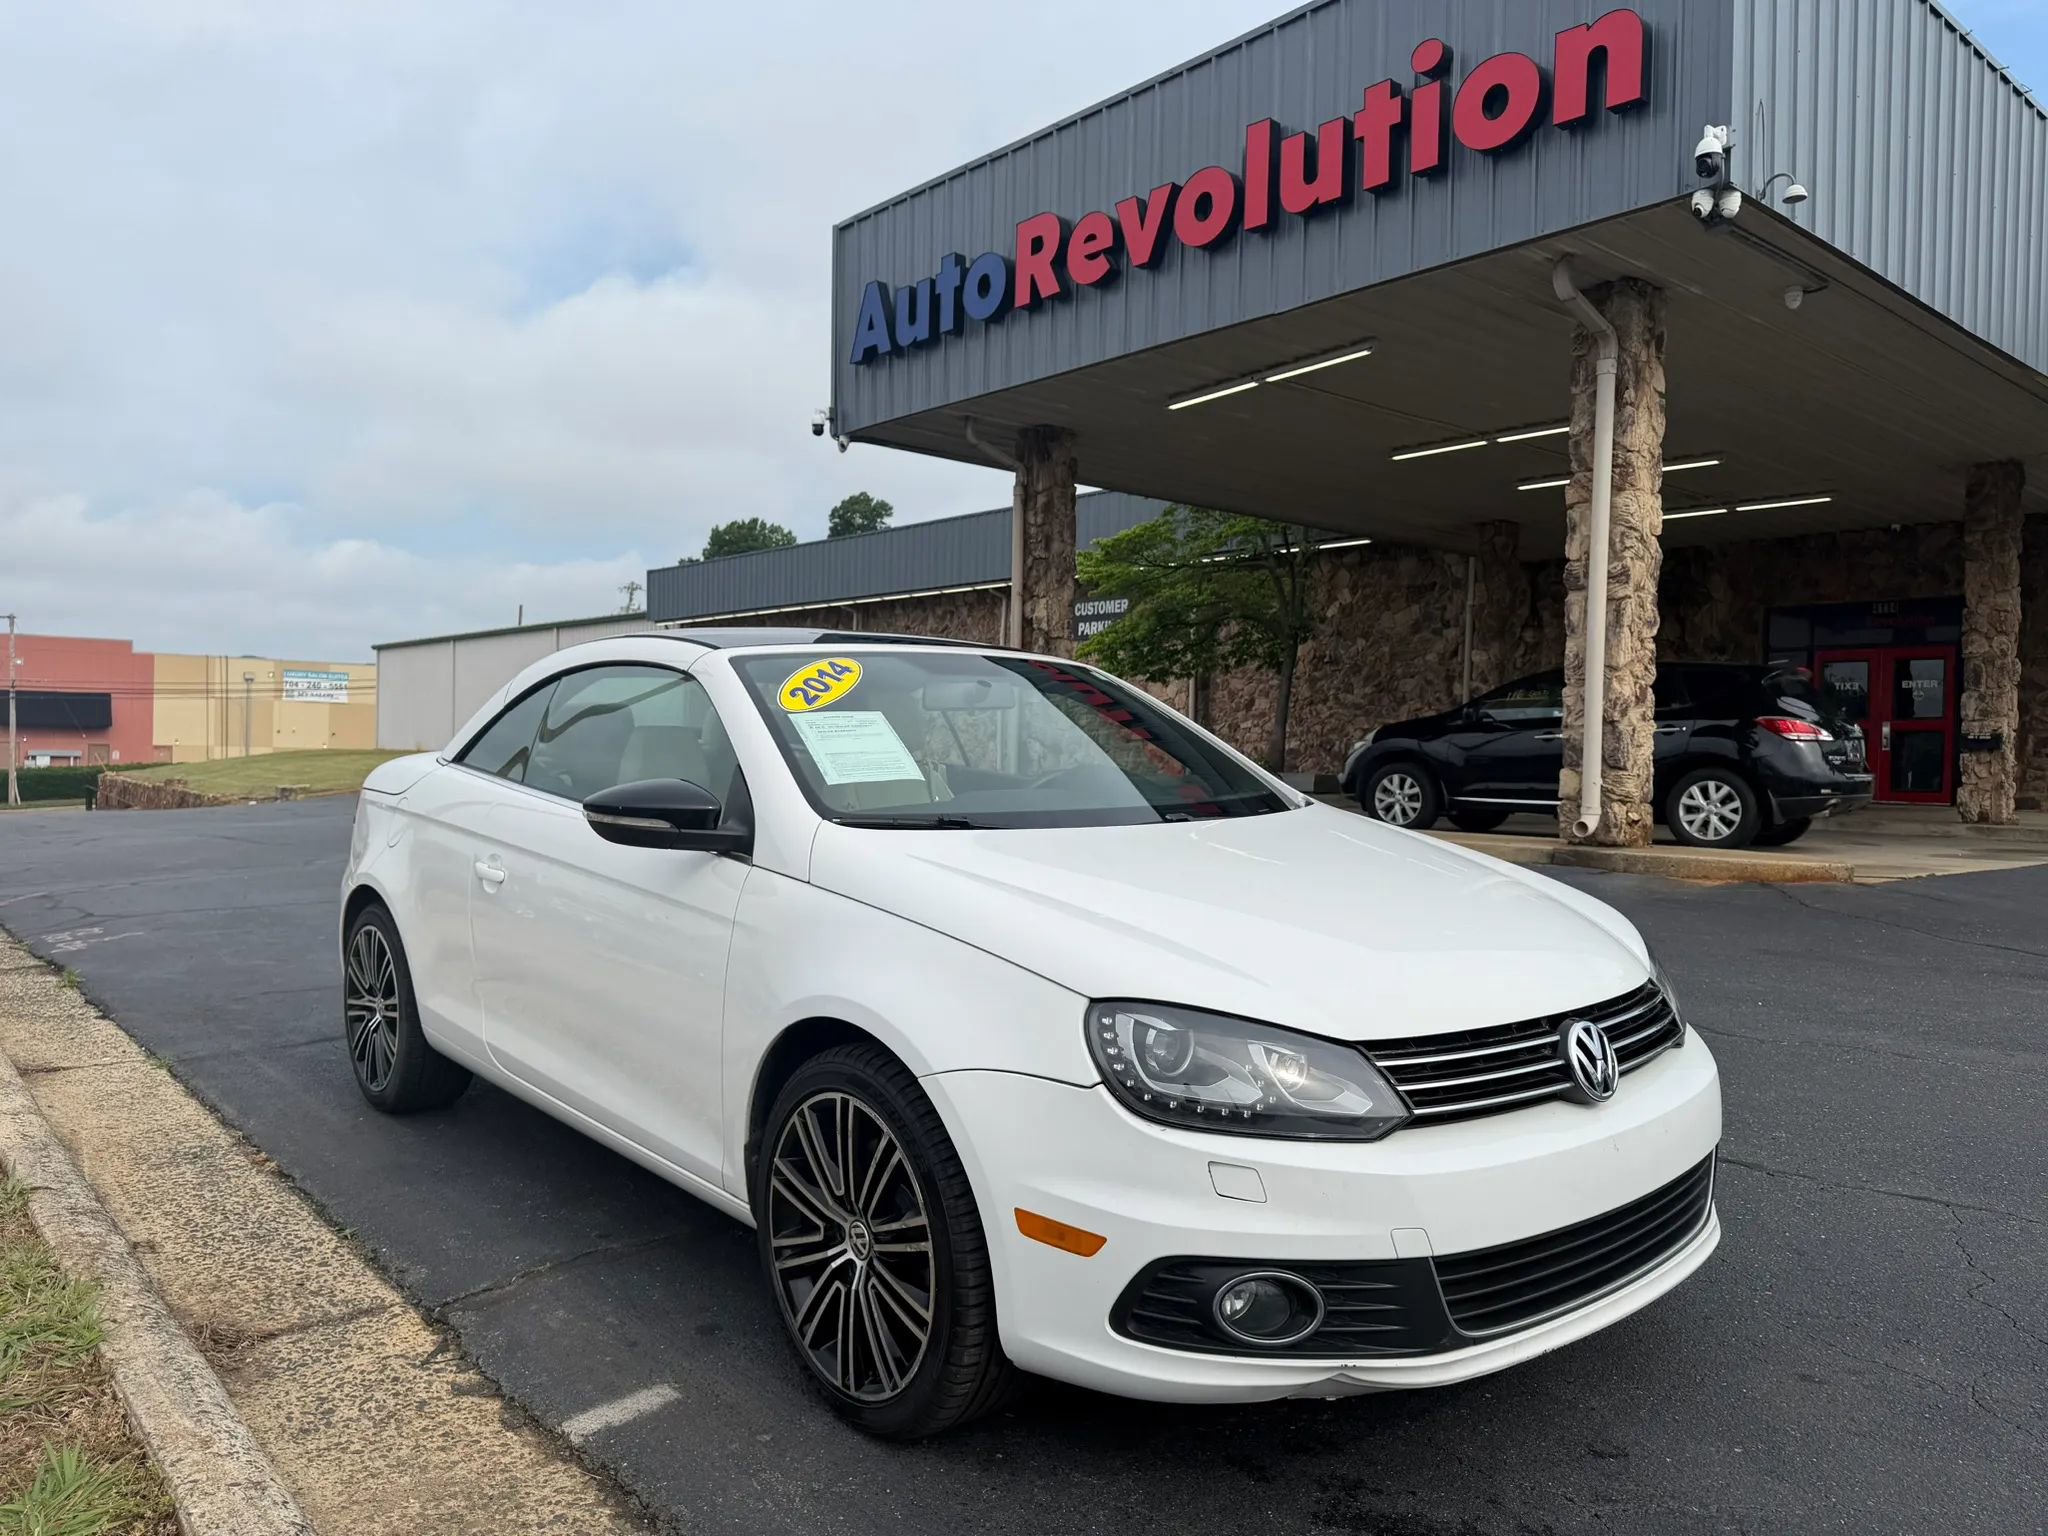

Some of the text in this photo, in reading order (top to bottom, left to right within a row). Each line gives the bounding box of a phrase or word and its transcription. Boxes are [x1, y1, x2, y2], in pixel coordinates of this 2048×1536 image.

[1074, 599, 1129, 616] CUSTOMER
[790, 661, 854, 706] 2014
[1901, 680, 1939, 689] ENTER
